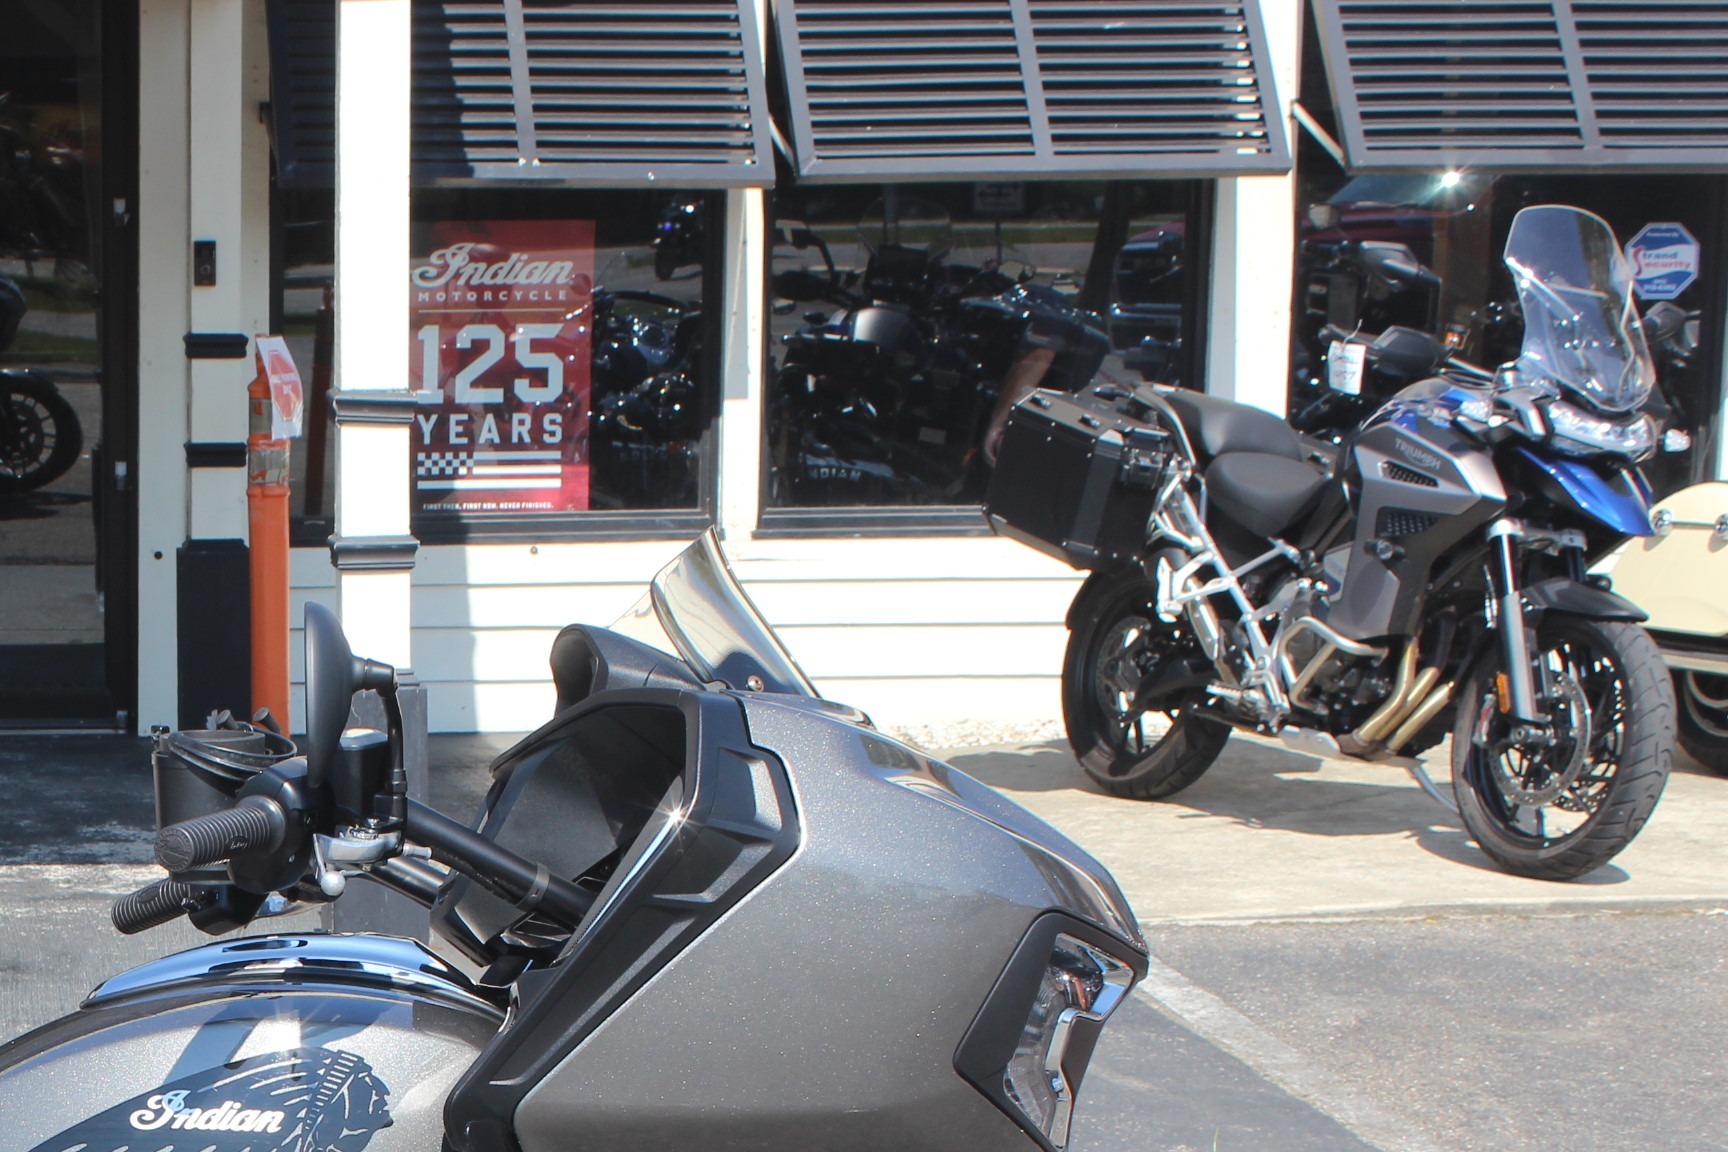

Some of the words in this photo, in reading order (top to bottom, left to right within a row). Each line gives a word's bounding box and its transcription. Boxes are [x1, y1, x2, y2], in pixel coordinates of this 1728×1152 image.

[412, 242, 575, 289] Indian
[418, 289, 568, 302] MOTORCYCLE
[416, 323, 564, 404] 125
[417, 412, 563, 446] YEARS
[1394, 437, 1441, 470] TRIUMPH
[129, 1089, 285, 1134] Indian
